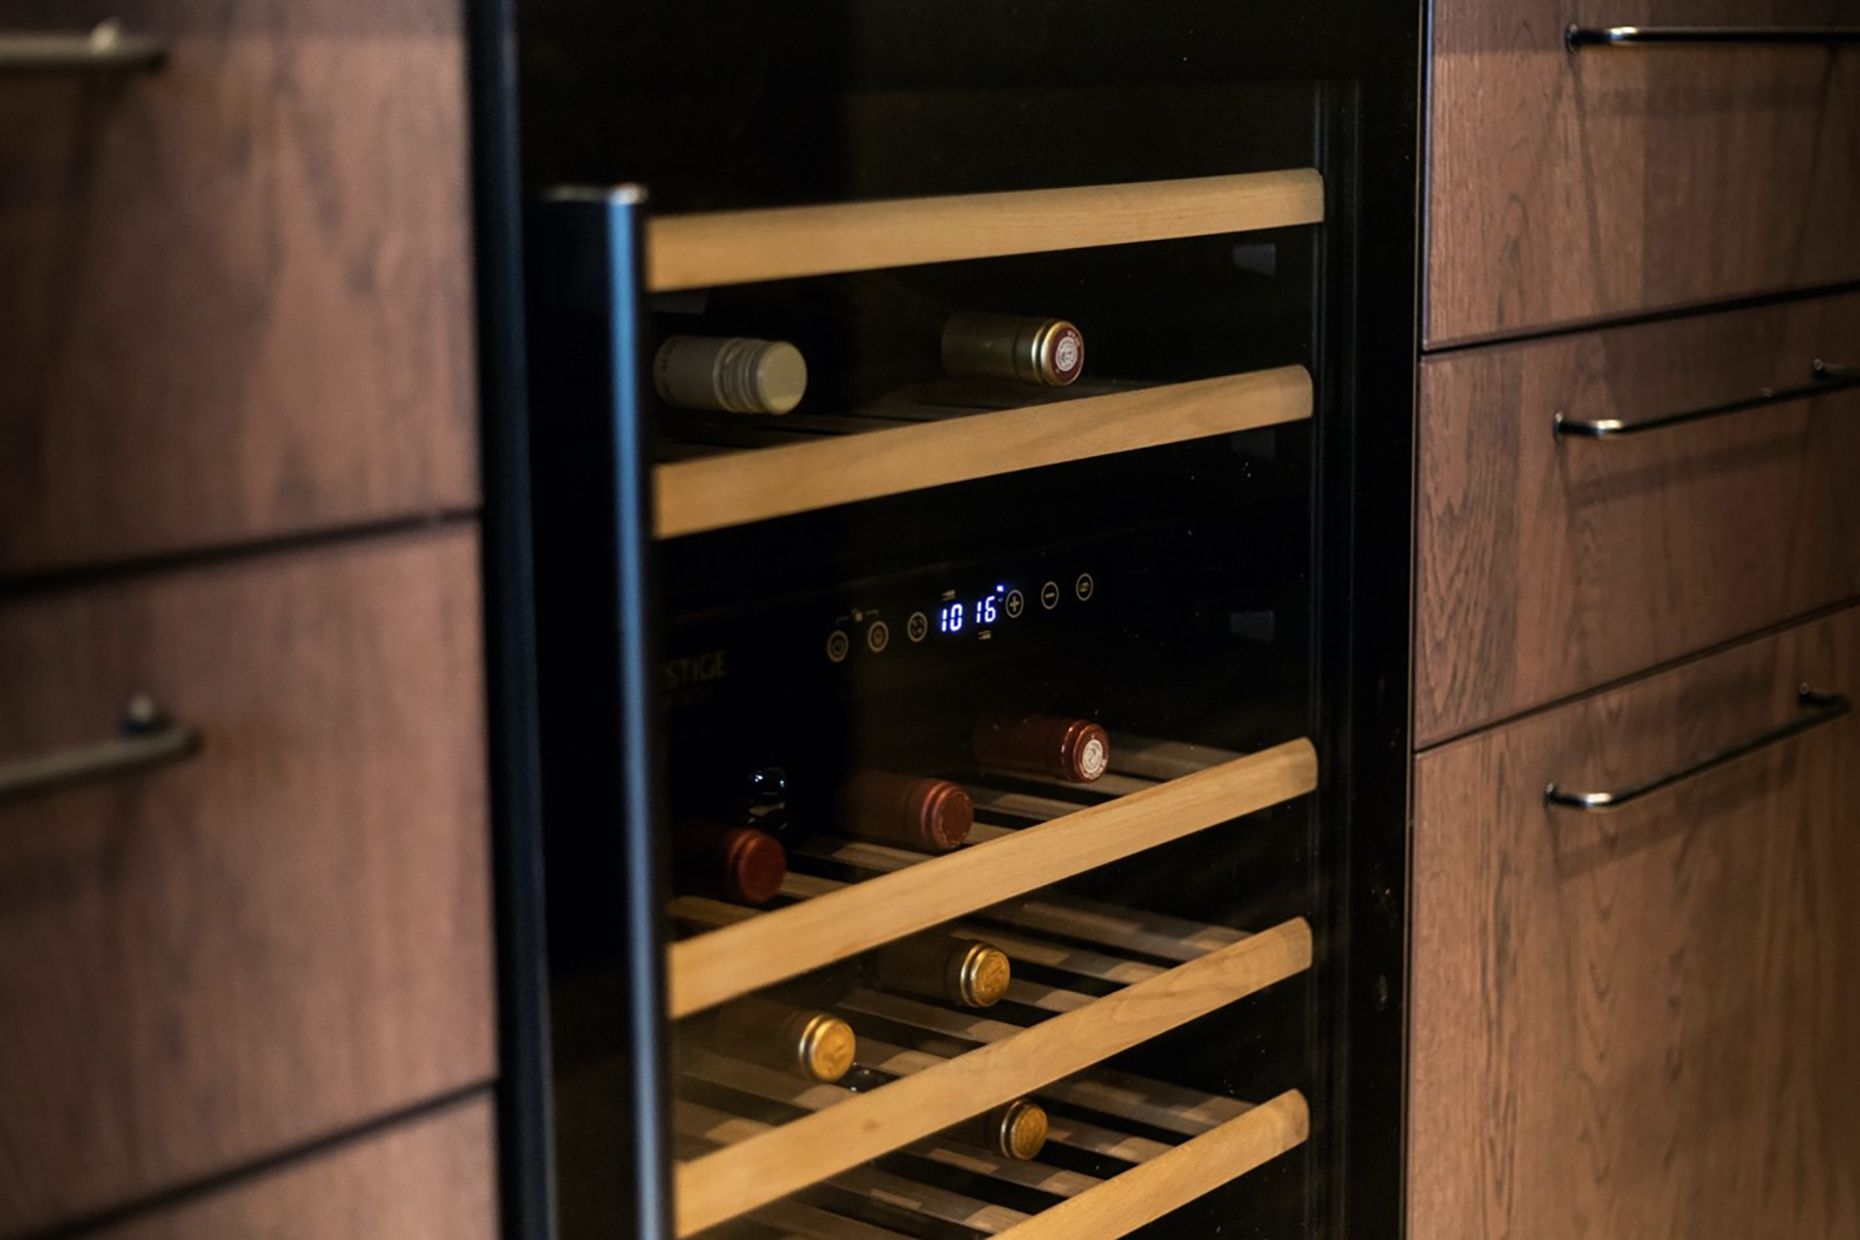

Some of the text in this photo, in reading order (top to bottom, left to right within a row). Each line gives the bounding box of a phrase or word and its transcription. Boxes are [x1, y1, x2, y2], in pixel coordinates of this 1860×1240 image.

[941, 595, 996, 632] 10 16
[665, 650, 728, 689] STIGE
